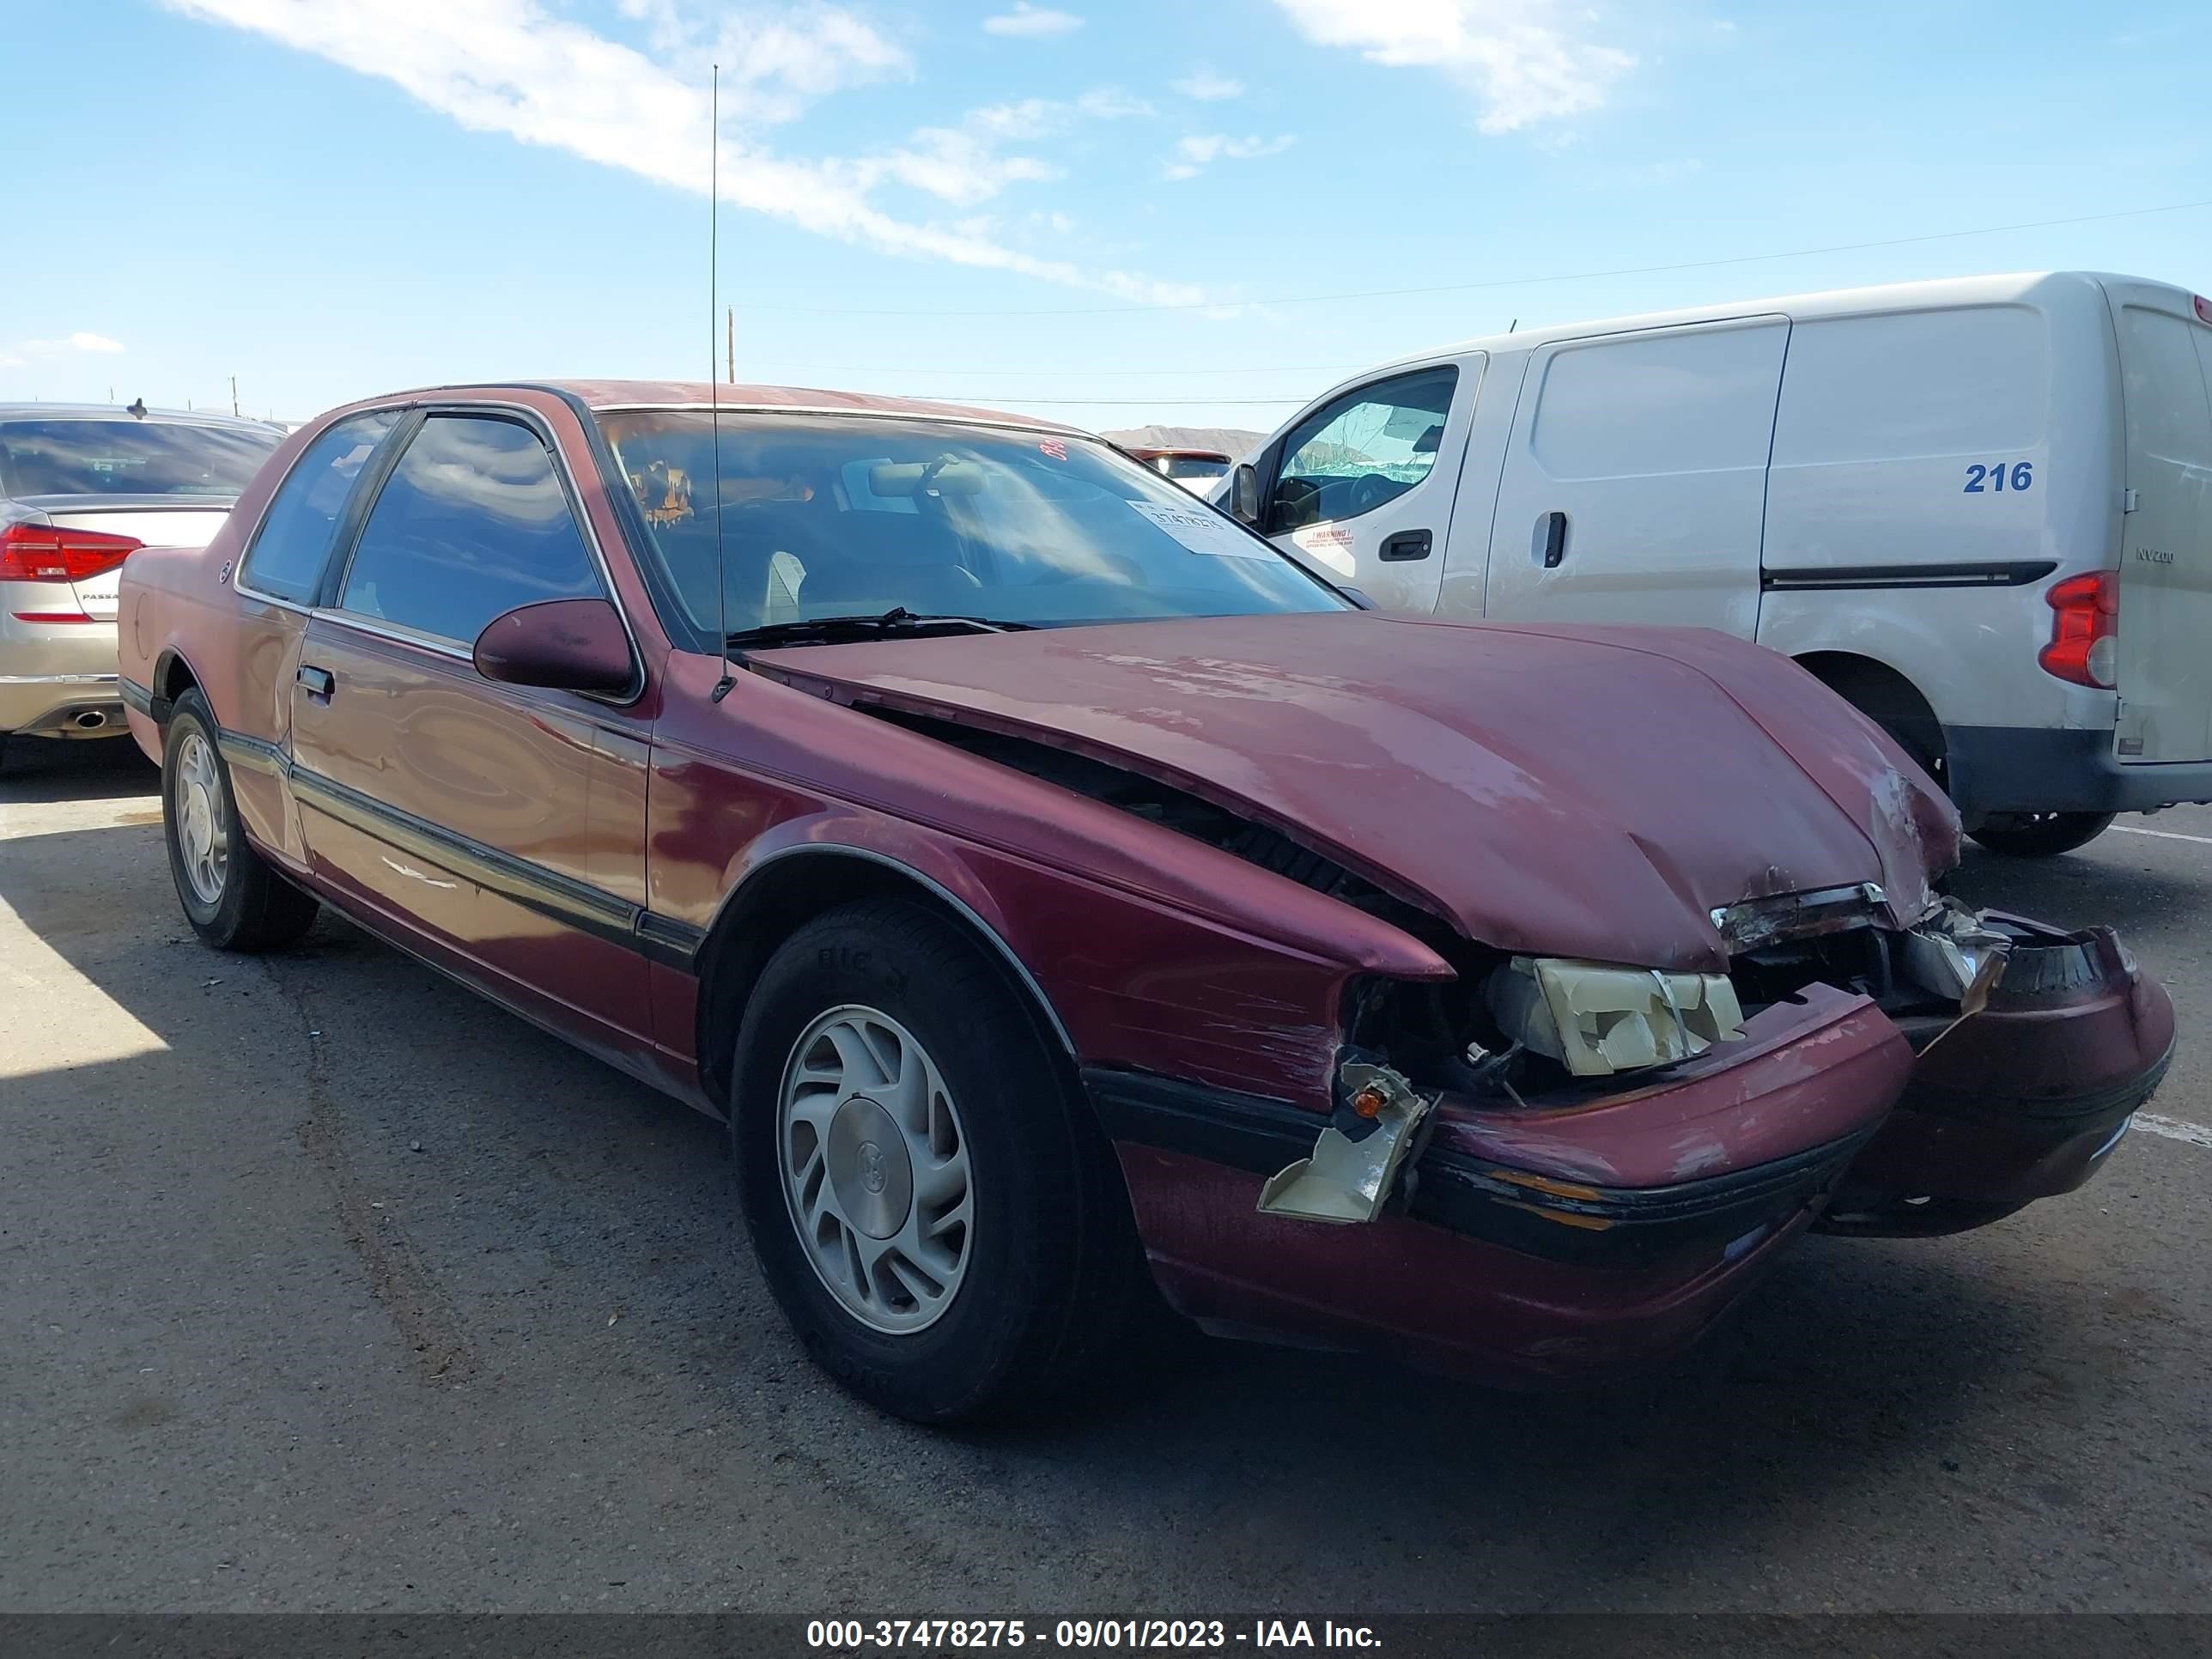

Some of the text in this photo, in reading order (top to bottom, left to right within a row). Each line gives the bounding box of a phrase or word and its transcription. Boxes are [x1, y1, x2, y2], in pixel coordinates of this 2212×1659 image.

[1964, 462, 2033, 493] 216
[1151, 513, 1224, 530] 37478275
[1316, 529, 1346, 539] WARNING
[2136, 548, 2175, 564] NV200
[818, 947, 872, 973] BIG
